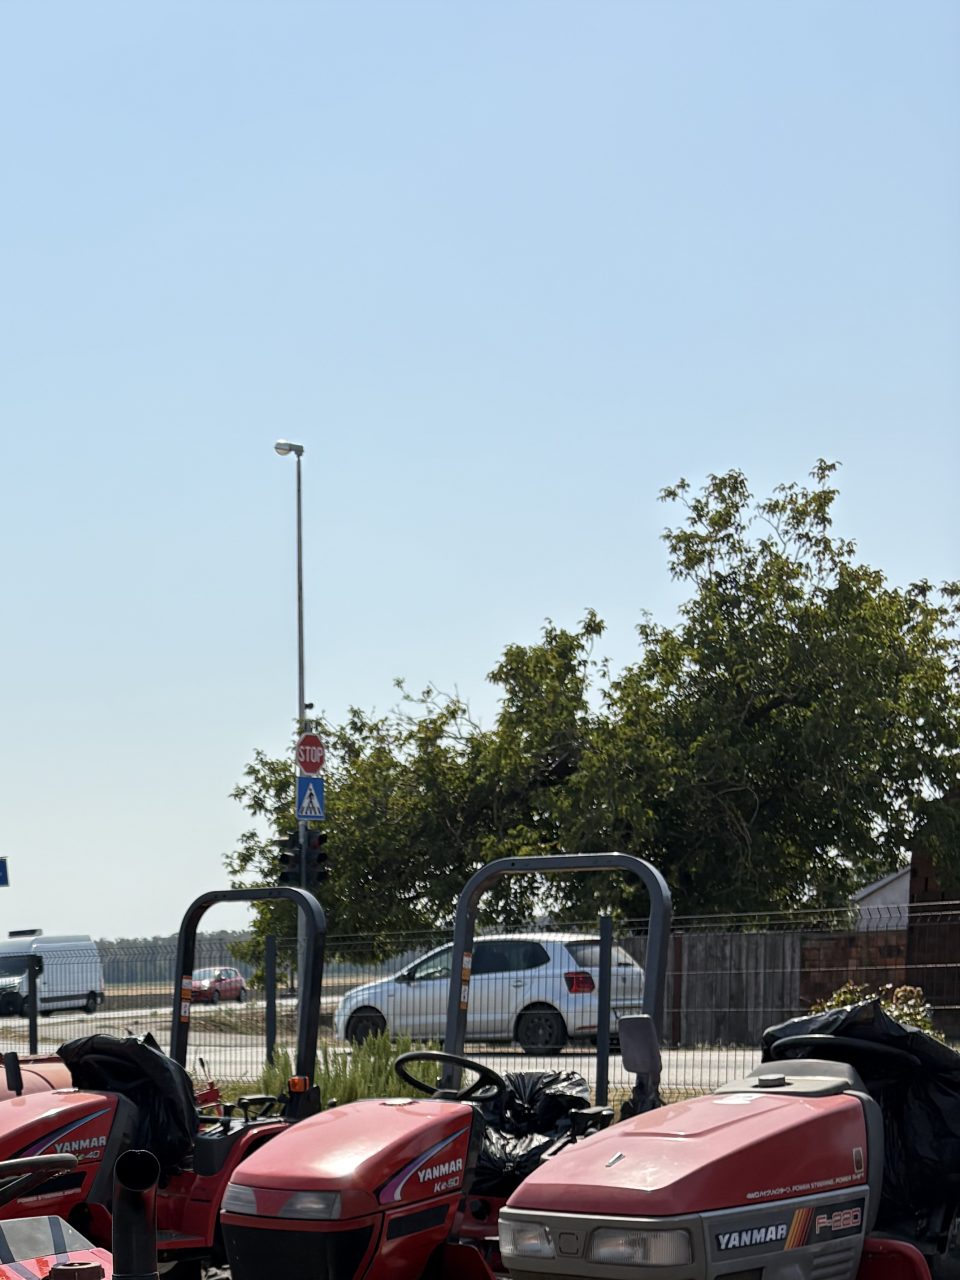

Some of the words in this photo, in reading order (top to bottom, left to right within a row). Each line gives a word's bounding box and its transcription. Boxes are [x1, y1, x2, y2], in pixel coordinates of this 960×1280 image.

[298, 746, 323, 763] STOP
[54, 1136, 107, 1154] YANMAR
[417, 1158, 463, 1183] YANMAR
[816, 1207, 861, 1235] F-220
[718, 1224, 787, 1250] YANMAR
